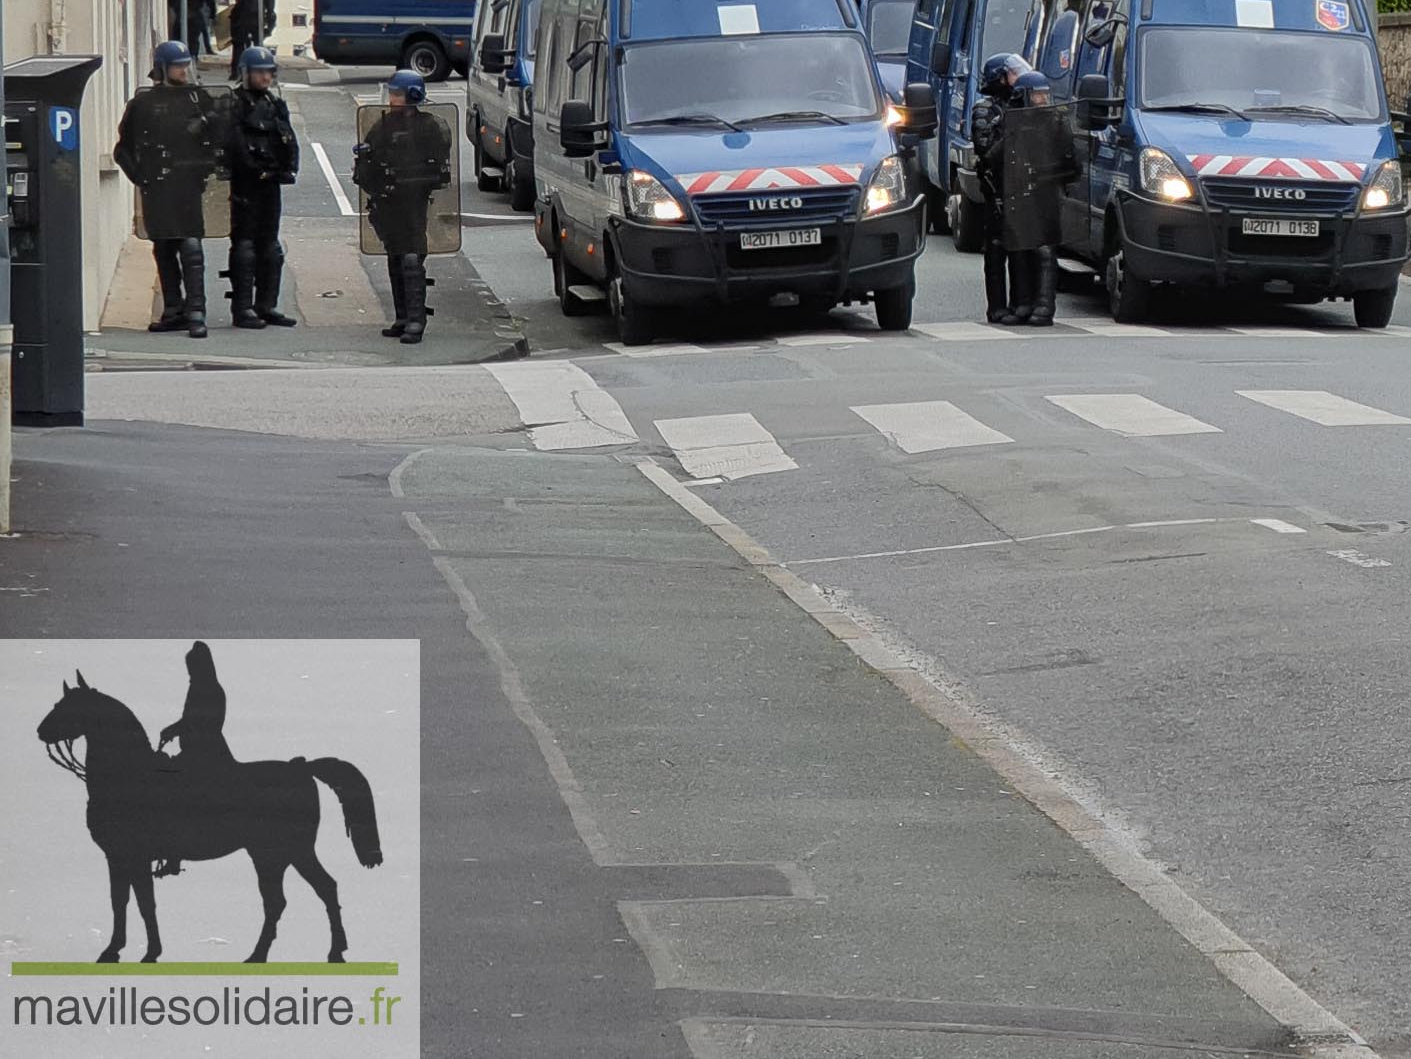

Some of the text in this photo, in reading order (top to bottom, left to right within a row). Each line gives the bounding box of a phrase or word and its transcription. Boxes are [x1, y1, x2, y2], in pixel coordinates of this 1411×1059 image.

[56, 110, 73, 143] P
[1255, 187, 1306, 200] IVECO
[749, 197, 803, 211] IVECO
